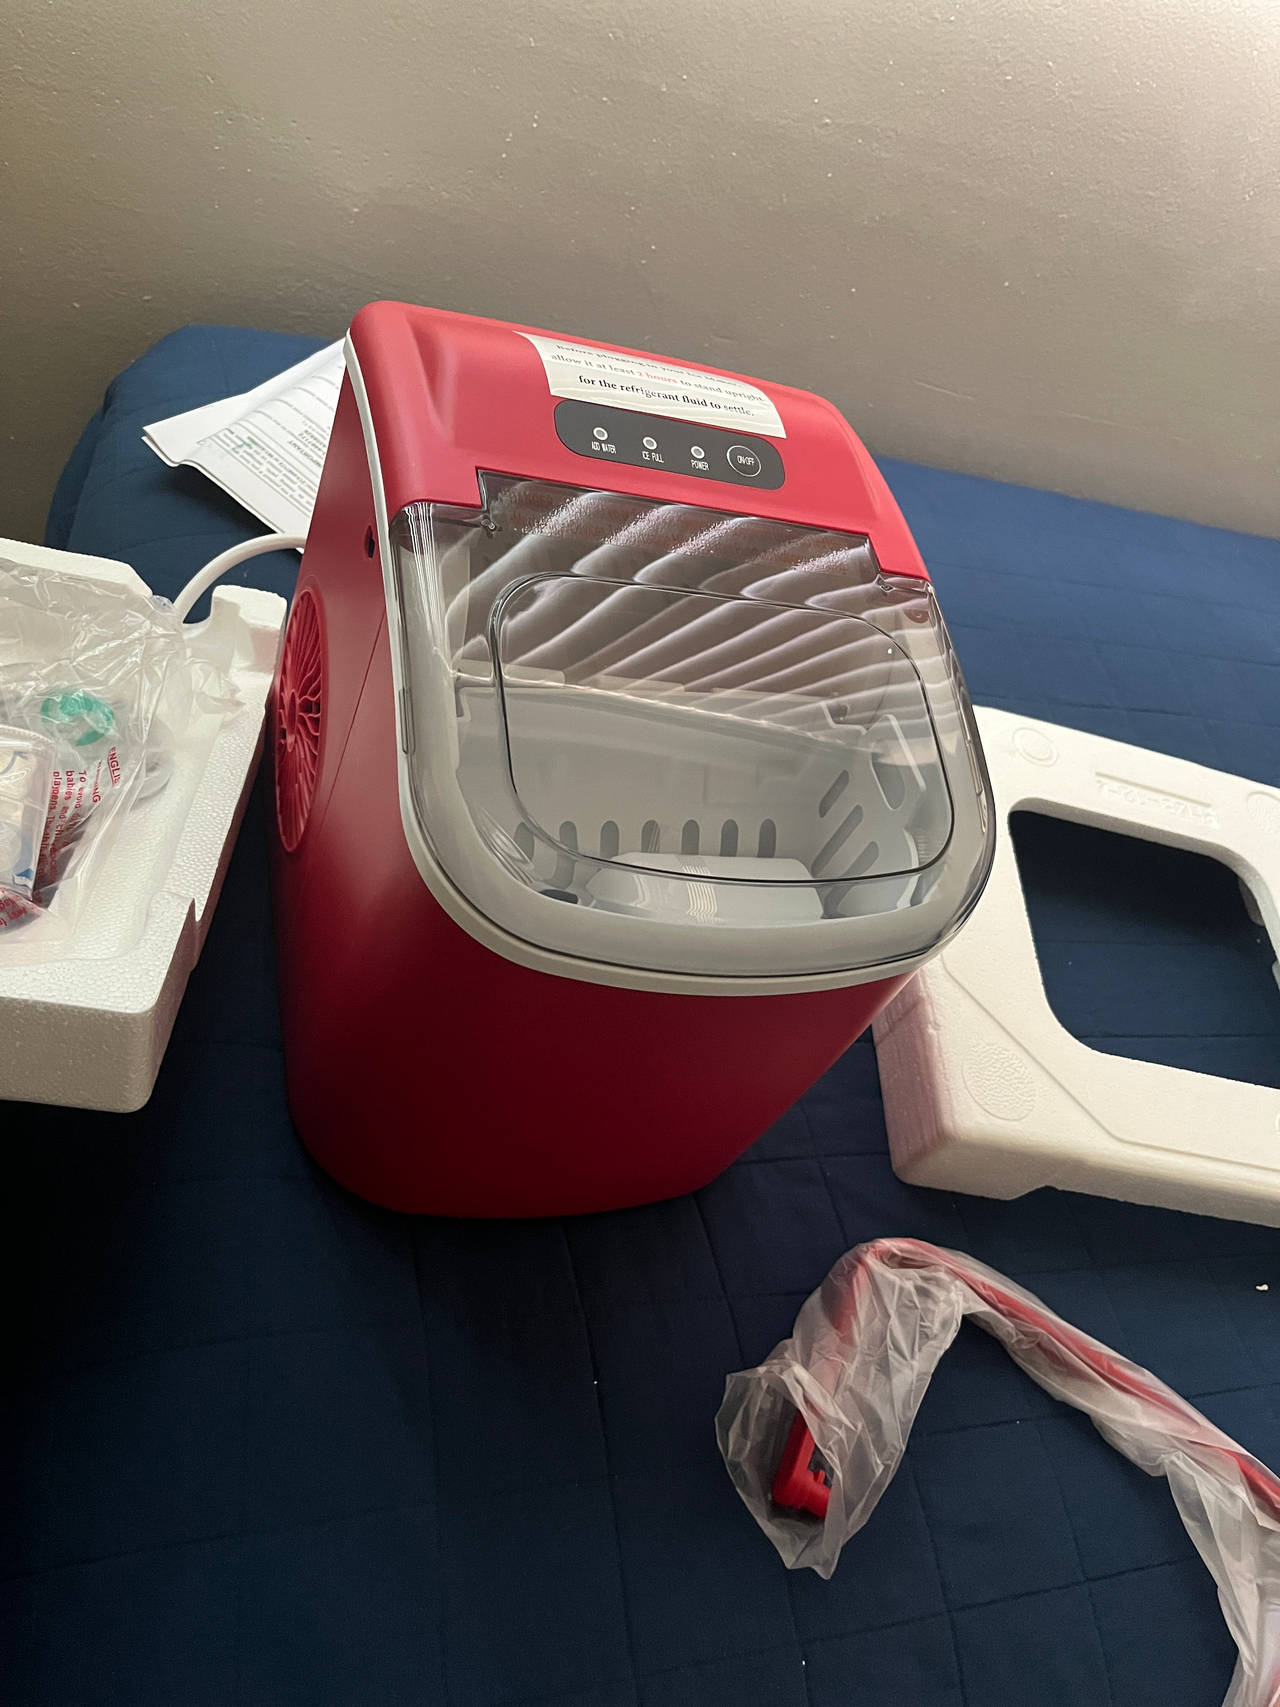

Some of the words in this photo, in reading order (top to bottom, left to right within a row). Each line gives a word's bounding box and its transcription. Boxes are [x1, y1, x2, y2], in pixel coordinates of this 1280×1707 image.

[551, 354, 582, 366] allow
[584, 359, 595, 367] it
[609, 364, 636, 376] least
[646, 372, 679, 384] hours
[680, 379, 692, 387] to
[694, 383, 724, 394] stand
[578, 375, 597, 386] for
[599, 379, 618, 390] the
[620, 383, 680, 403] refrigerant
[682, 395, 708, 408] fluid
[710, 402, 722, 410] to
[723, 405, 755, 418] settle.
[591, 441, 602, 452] ADD
[602, 443, 617, 455] WATER
[641, 450, 650, 461] ICE
[651, 452, 665, 464] FULL
[690, 459, 710, 472] POWER
[64, 770, 75, 801] babies
